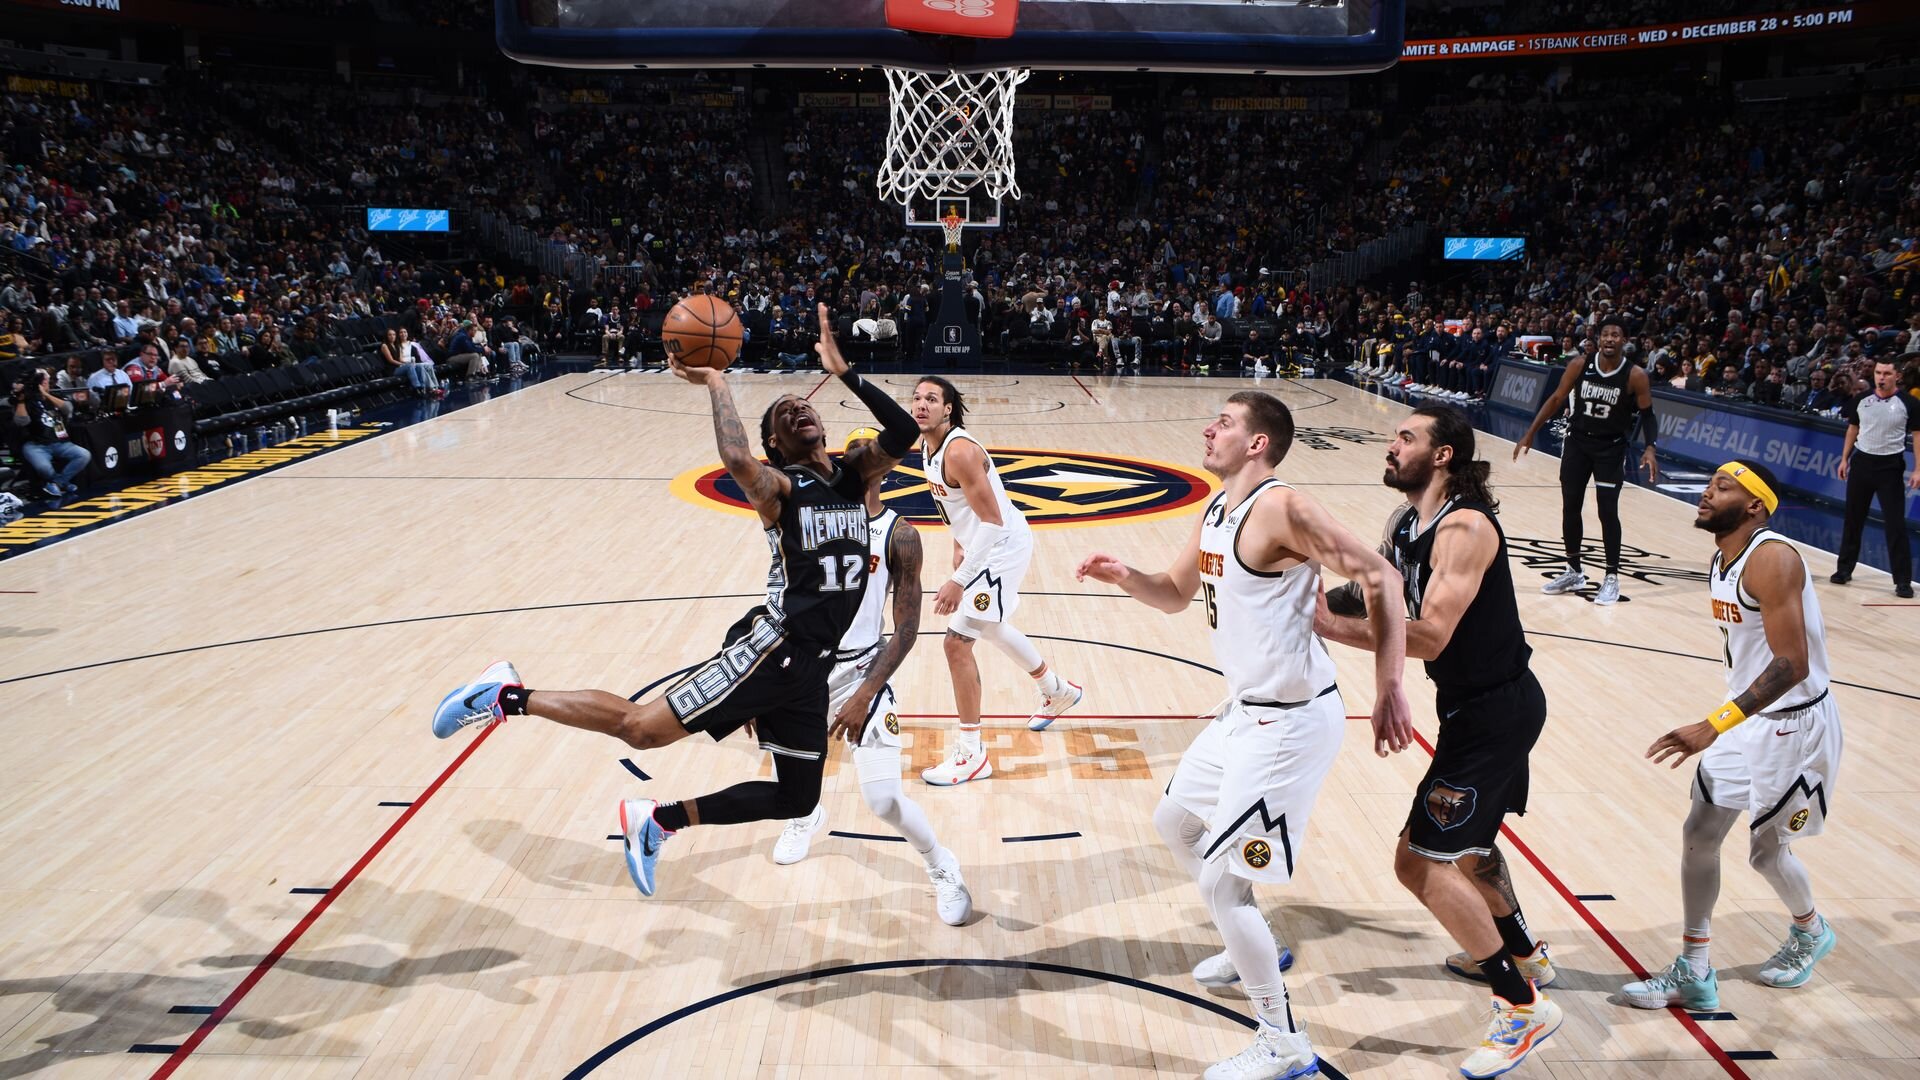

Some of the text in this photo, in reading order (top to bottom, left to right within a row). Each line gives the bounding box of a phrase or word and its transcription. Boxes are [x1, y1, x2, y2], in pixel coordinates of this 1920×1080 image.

[1439, 44, 1449, 54] &
[1452, 40, 1516, 54] RAMPAGE
[1527, 36, 1579, 50] 1STBANK
[1583, 33, 1628, 47] CENTER
[1638, 28, 1668, 43] WED
[1681, 19, 1757, 40] DECEMBER
[1760, 17, 1777, 31] 28
[1792, 13, 1824, 28] 5:00
[1827, 9, 1853, 25] PM
[1501, 373, 1537, 404] KICKS
[1580, 380, 1621, 405] MEMPHIS
[1583, 401, 1612, 419] 13
[1659, 413, 1847, 482] WE ARE ALL SNEAK
[799, 504, 868, 551] MEMPHIS
[818, 554, 864, 592] 12
